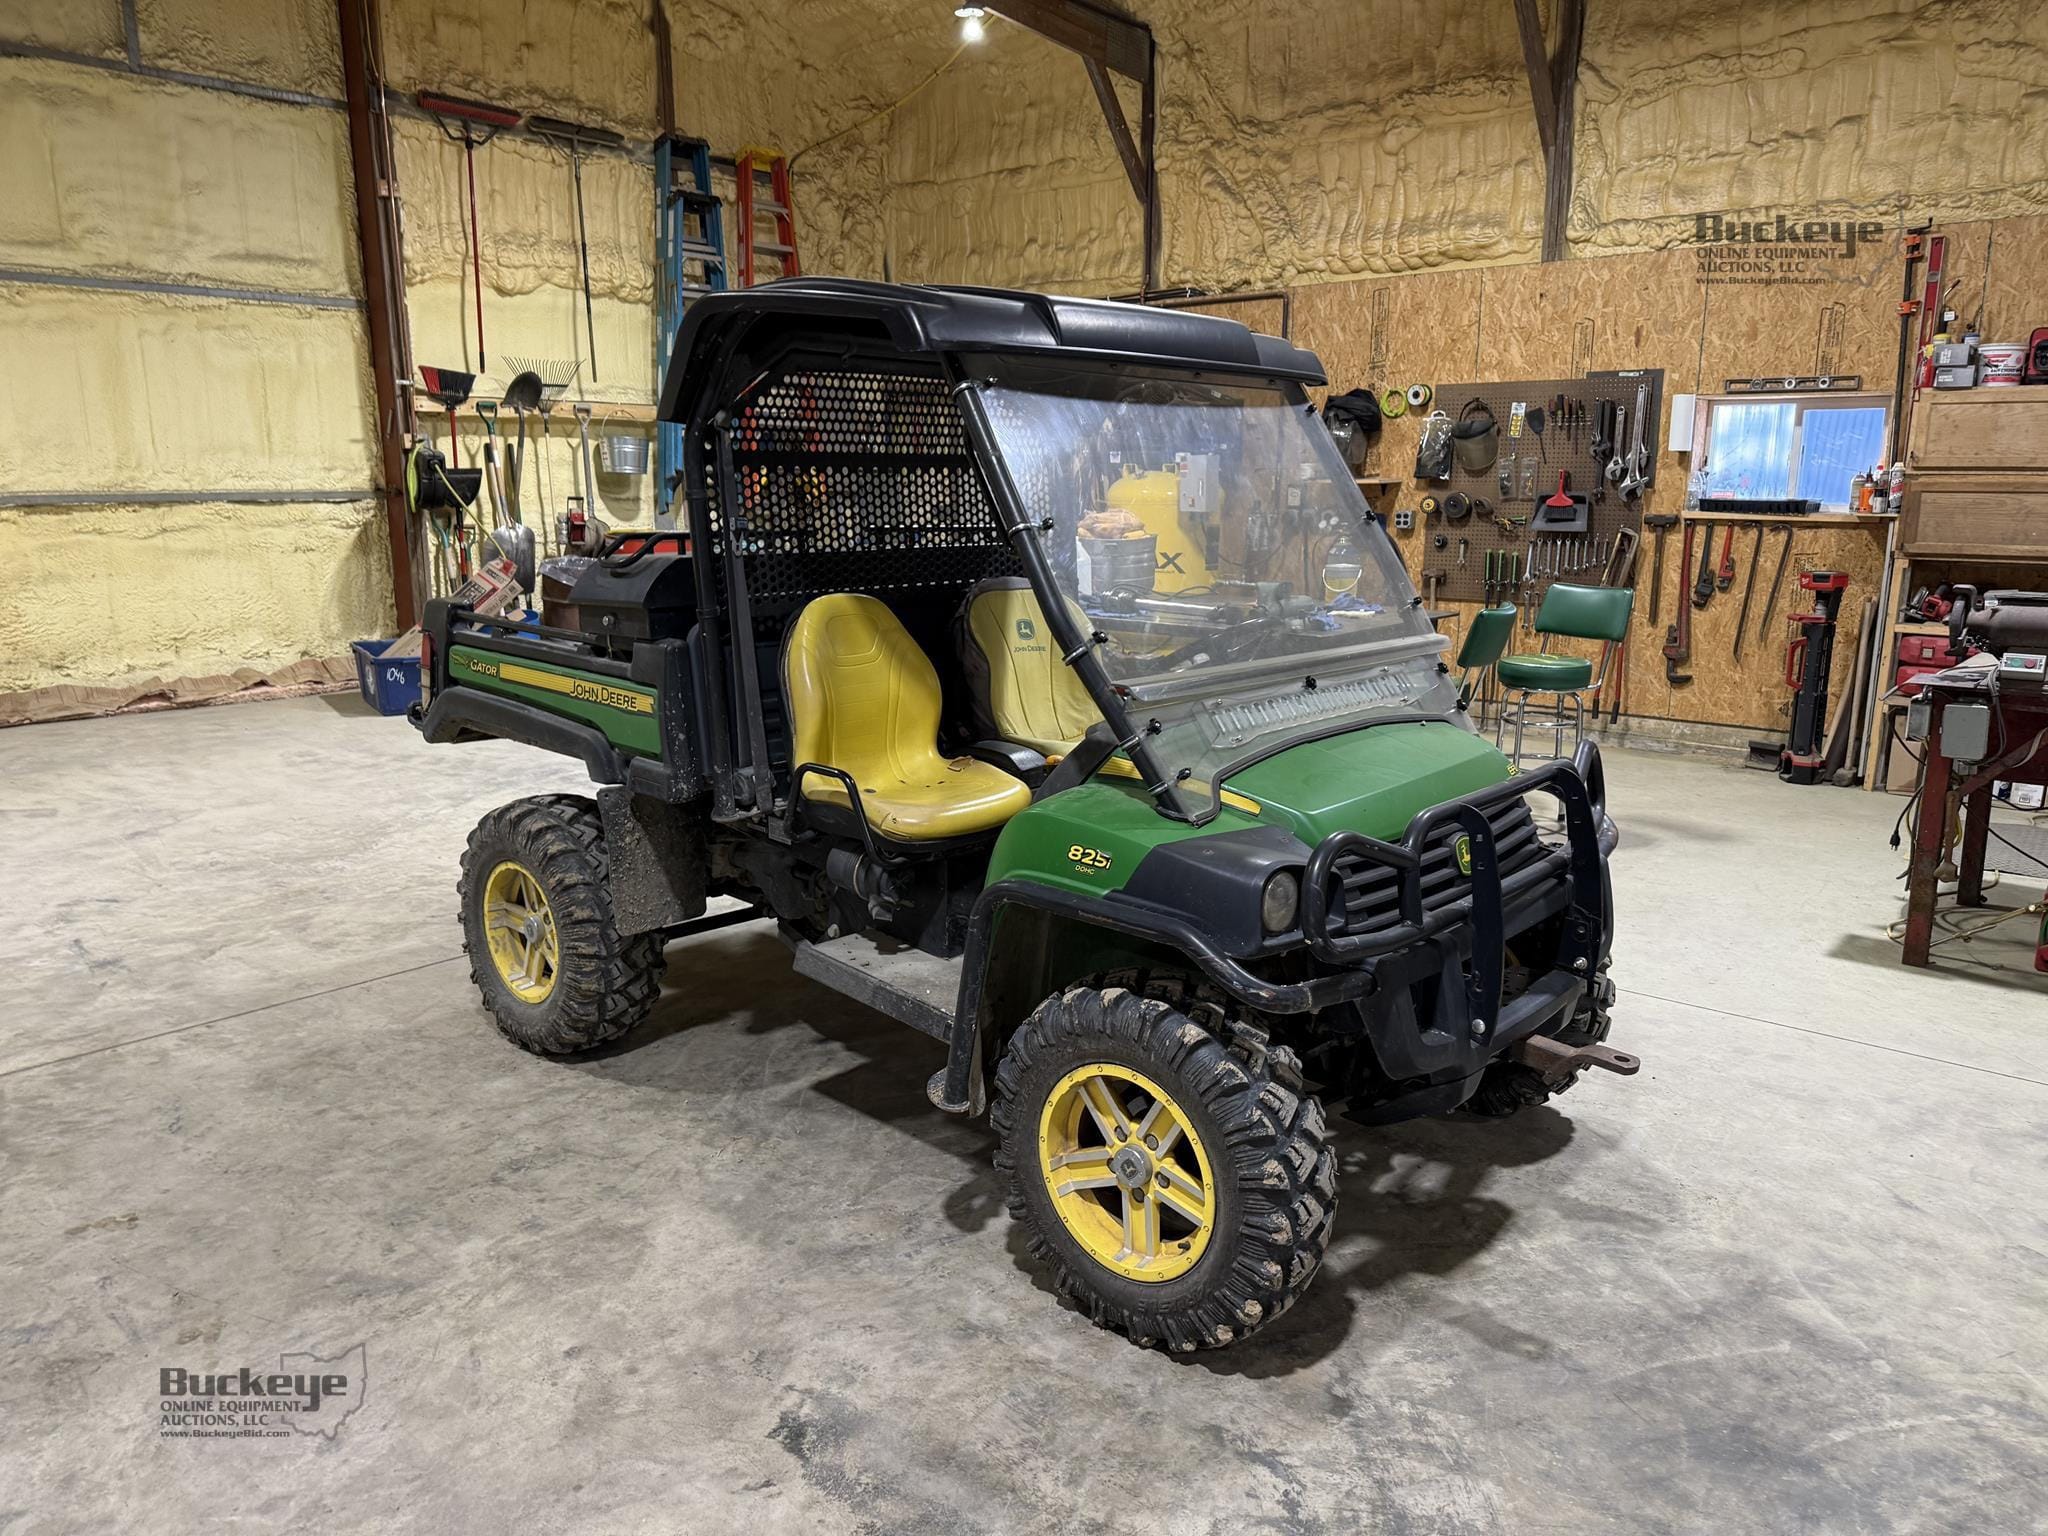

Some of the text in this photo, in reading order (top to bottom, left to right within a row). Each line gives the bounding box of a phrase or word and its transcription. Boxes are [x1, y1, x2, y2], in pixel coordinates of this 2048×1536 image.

[470, 659, 498, 677] GATOR
[570, 681, 638, 709] JOHN DEERE
[1067, 844, 1112, 870] 825i
